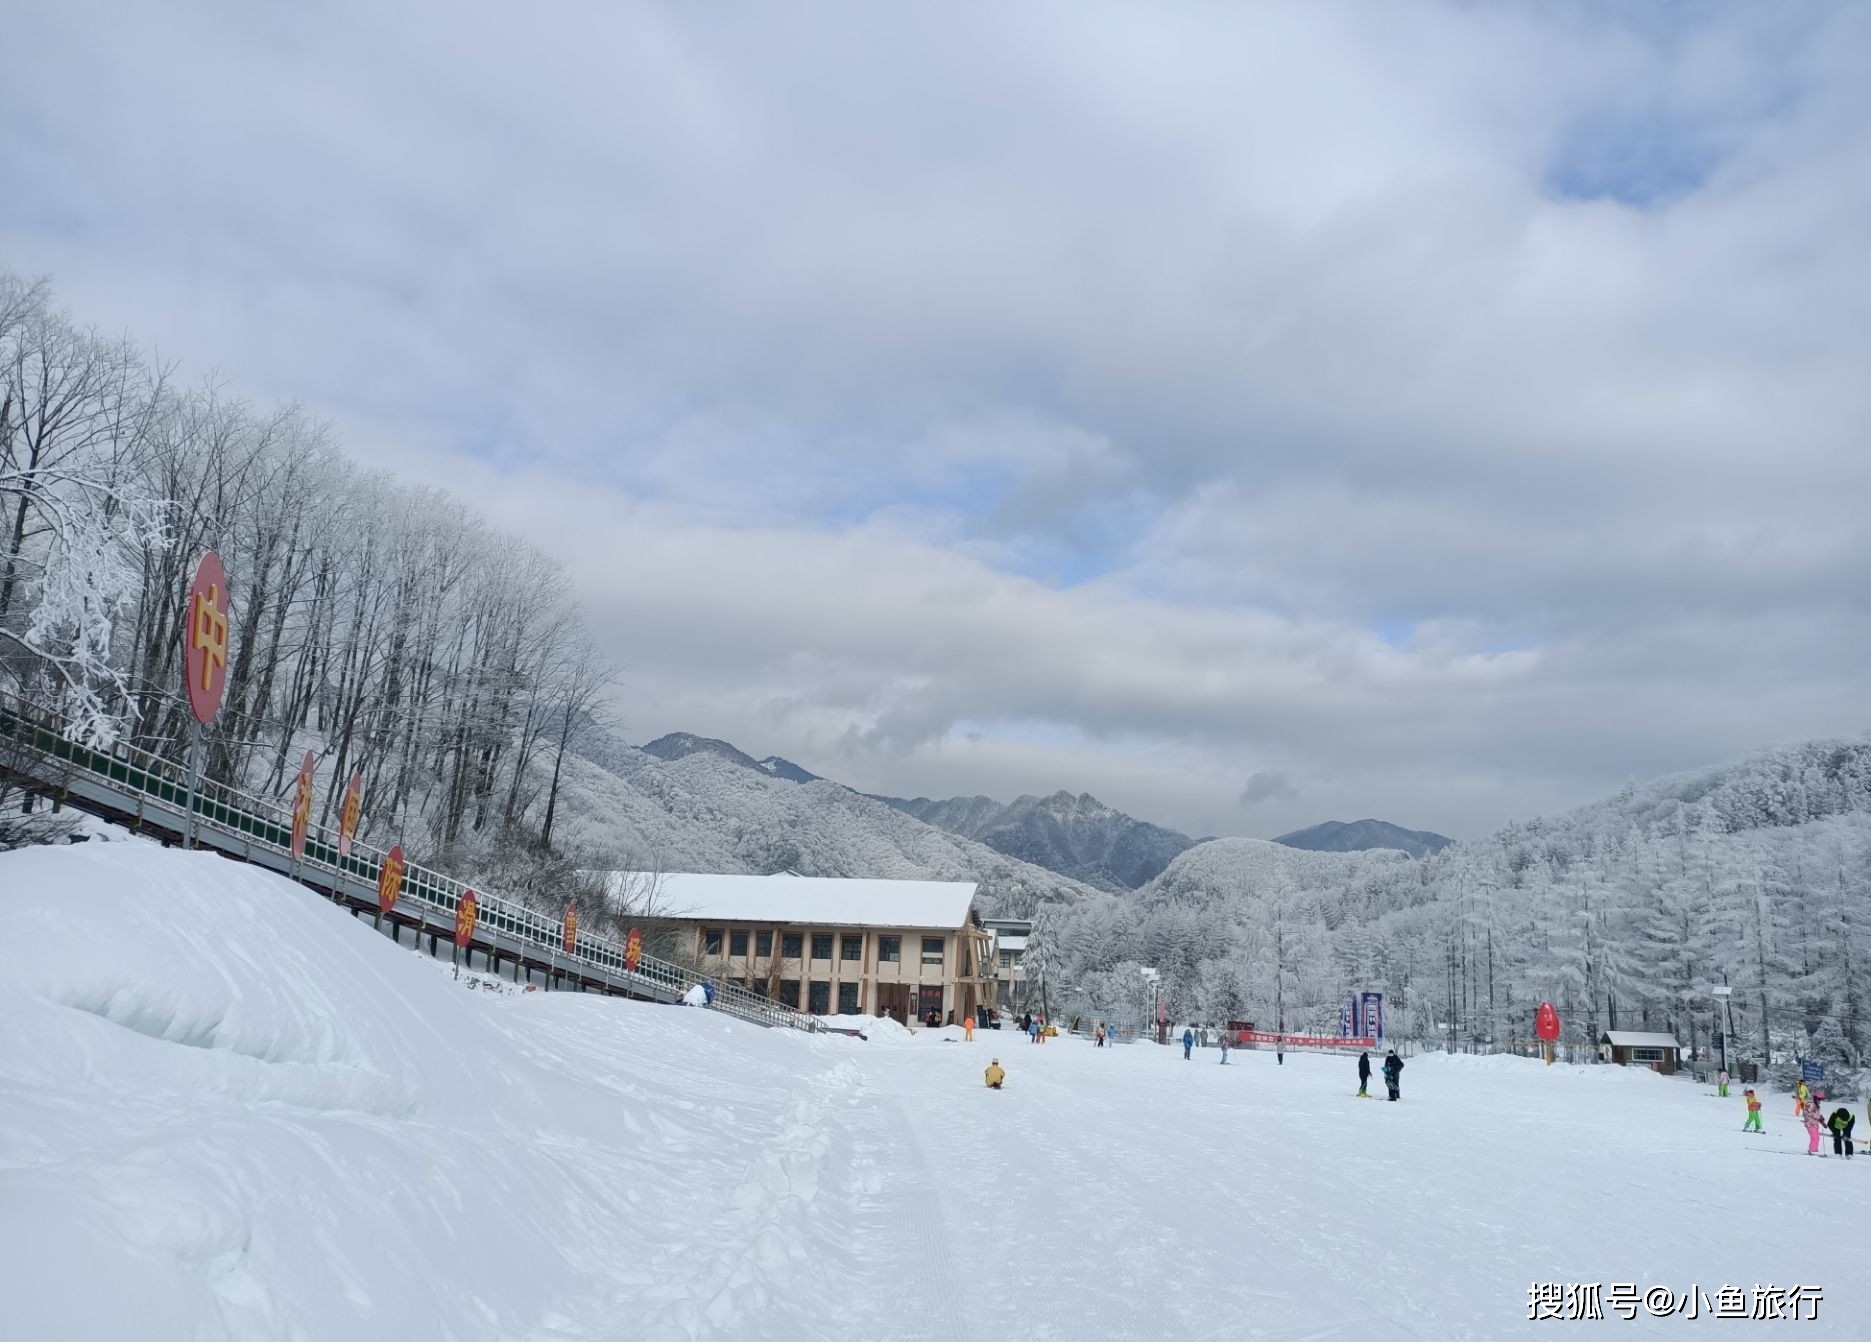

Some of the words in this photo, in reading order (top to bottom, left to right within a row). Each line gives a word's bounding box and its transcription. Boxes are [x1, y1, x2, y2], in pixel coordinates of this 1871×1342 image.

[193, 583, 229, 691] 中
[341, 787, 362, 841] 国
[381, 857, 404, 902] 际
[457, 899, 477, 936] 滑
[626, 937, 642, 964] 场
